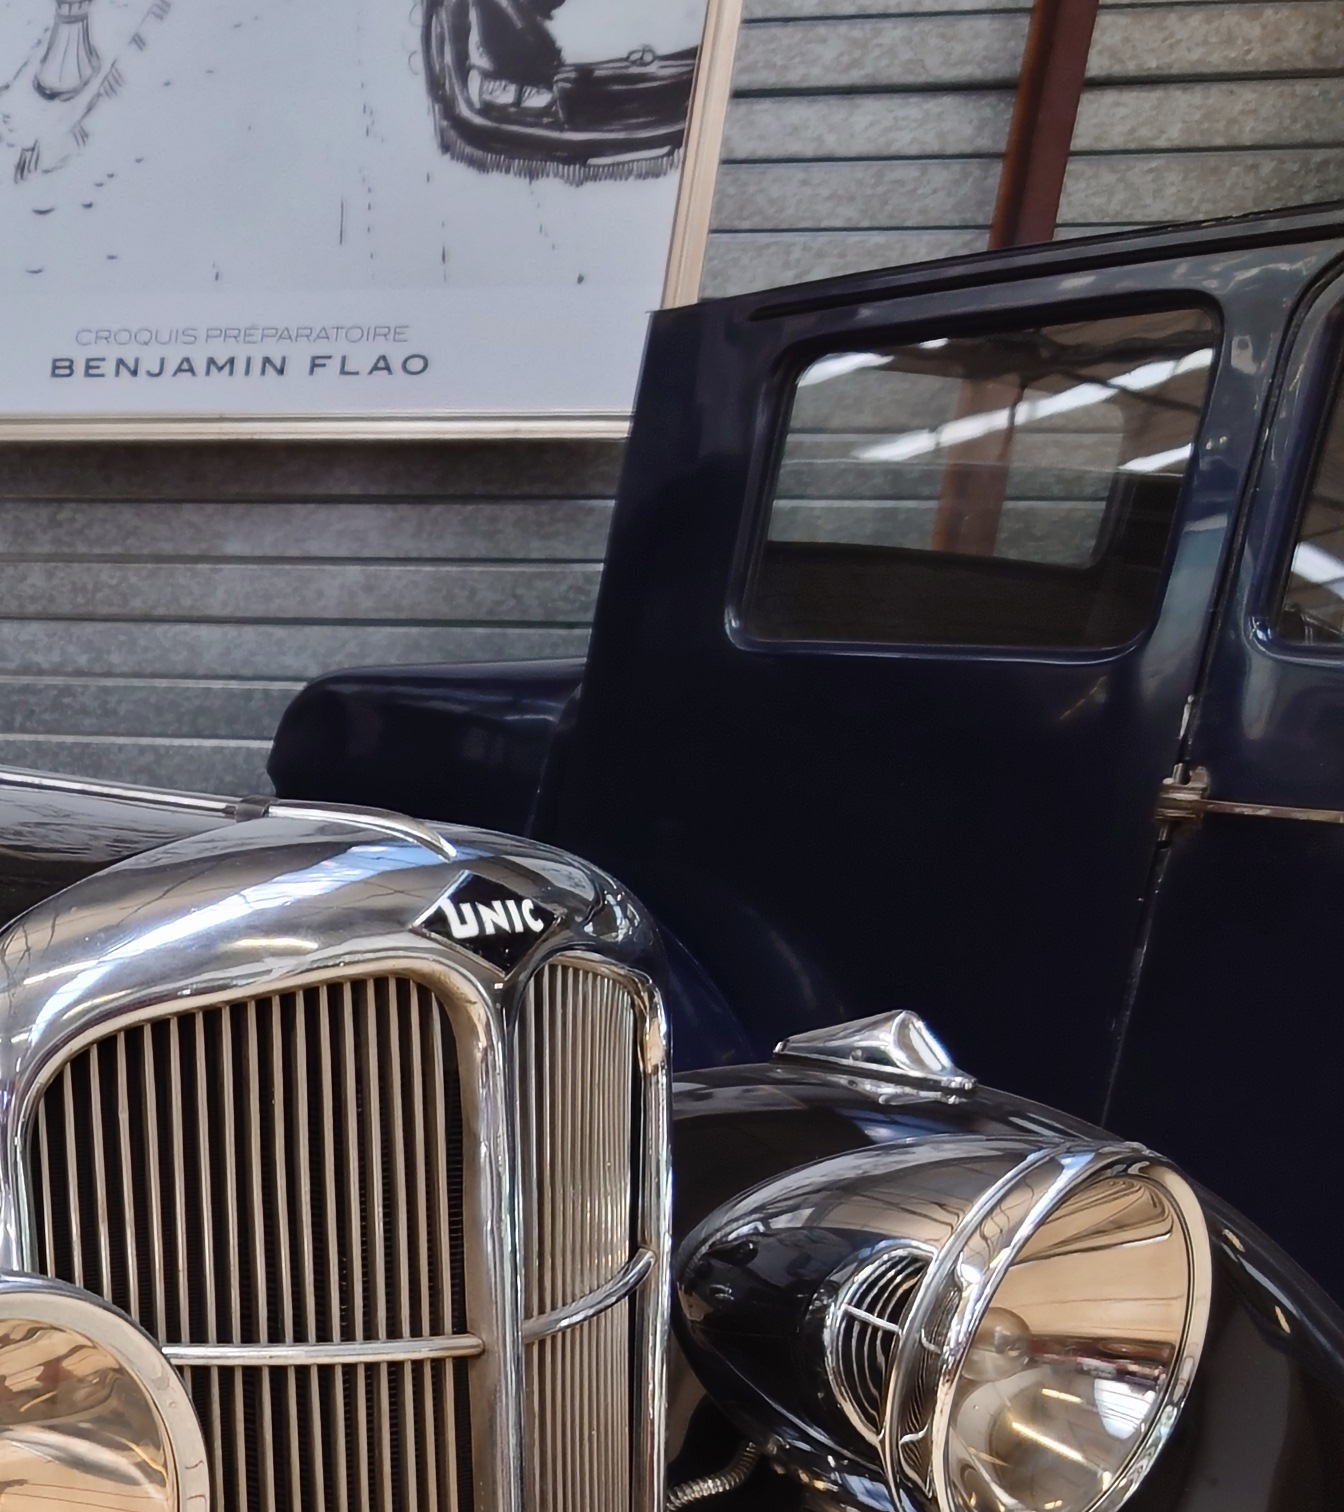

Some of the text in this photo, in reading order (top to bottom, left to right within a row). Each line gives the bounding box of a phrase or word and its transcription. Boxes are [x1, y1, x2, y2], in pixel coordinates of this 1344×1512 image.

[75, 323, 410, 347] CROQUIS PRÉPARATOIRE
[49, 353, 430, 379] BENJAMIN FLAO
[439, 897, 545, 939] UNIC
